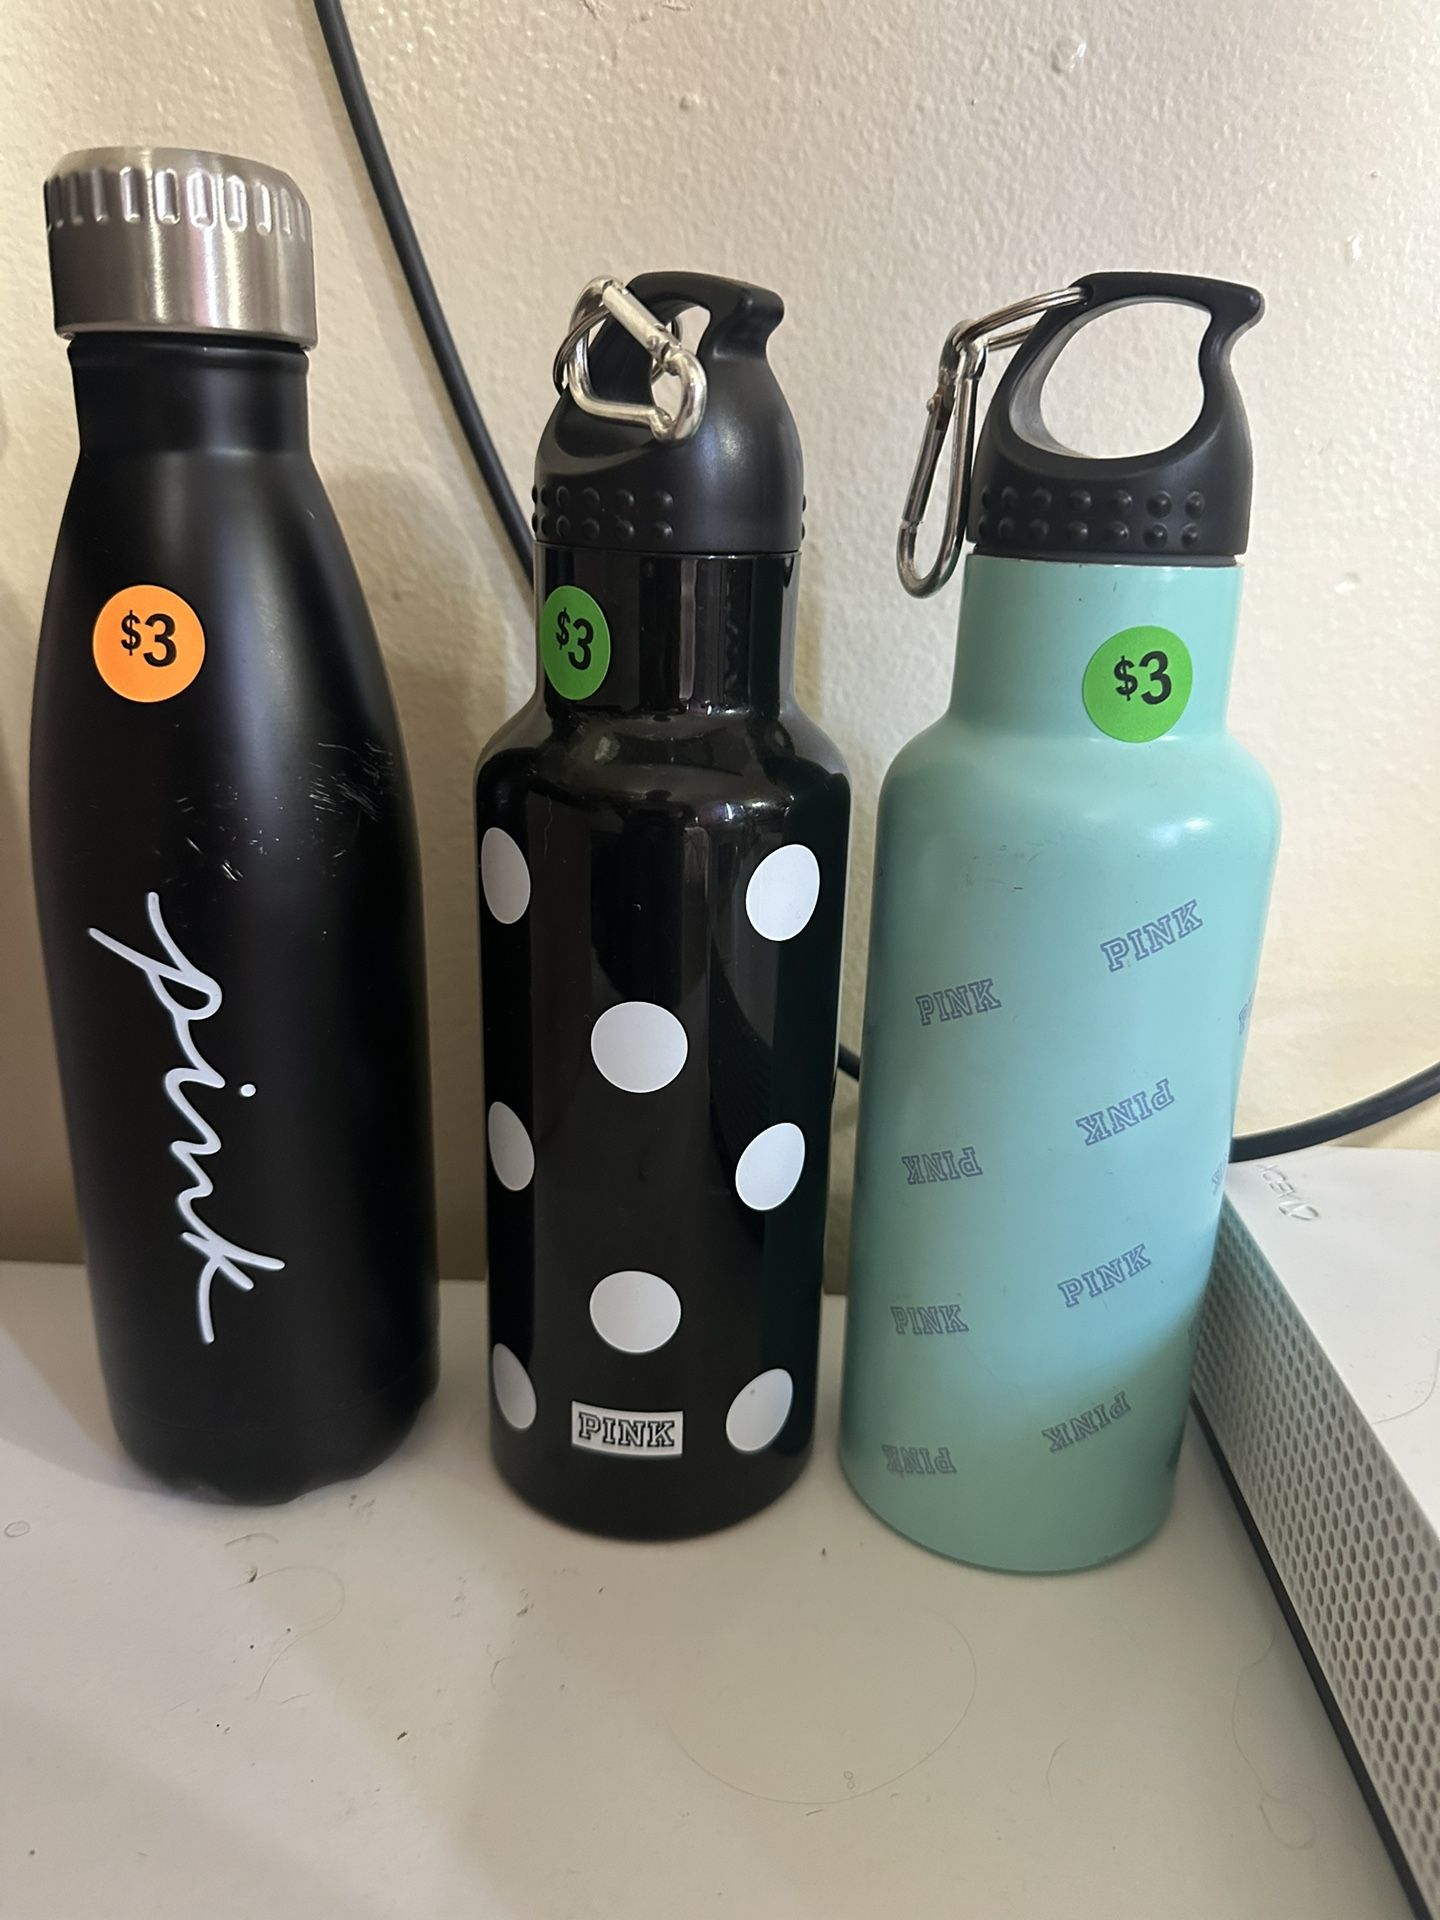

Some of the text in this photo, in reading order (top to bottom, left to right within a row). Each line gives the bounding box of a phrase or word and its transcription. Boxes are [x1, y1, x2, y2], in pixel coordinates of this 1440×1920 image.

[120, 610, 177, 667] $3
[556, 608, 593, 671] $3
[1114, 650, 1172, 705] $3
[1100, 899, 1203, 972] PINK
[915, 978, 1002, 1026] PINK
[88, 892, 285, 1344] pink
[1075, 1079, 1174, 1145] PINK
[902, 1147, 983, 1184] PINK
[1058, 1243, 1151, 1308] PINK
[892, 1305, 969, 1334] PINK
[578, 1412, 676, 1448] PINK
[1042, 1391, 1131, 1453] PINK
[882, 1444, 957, 1475] PINK
